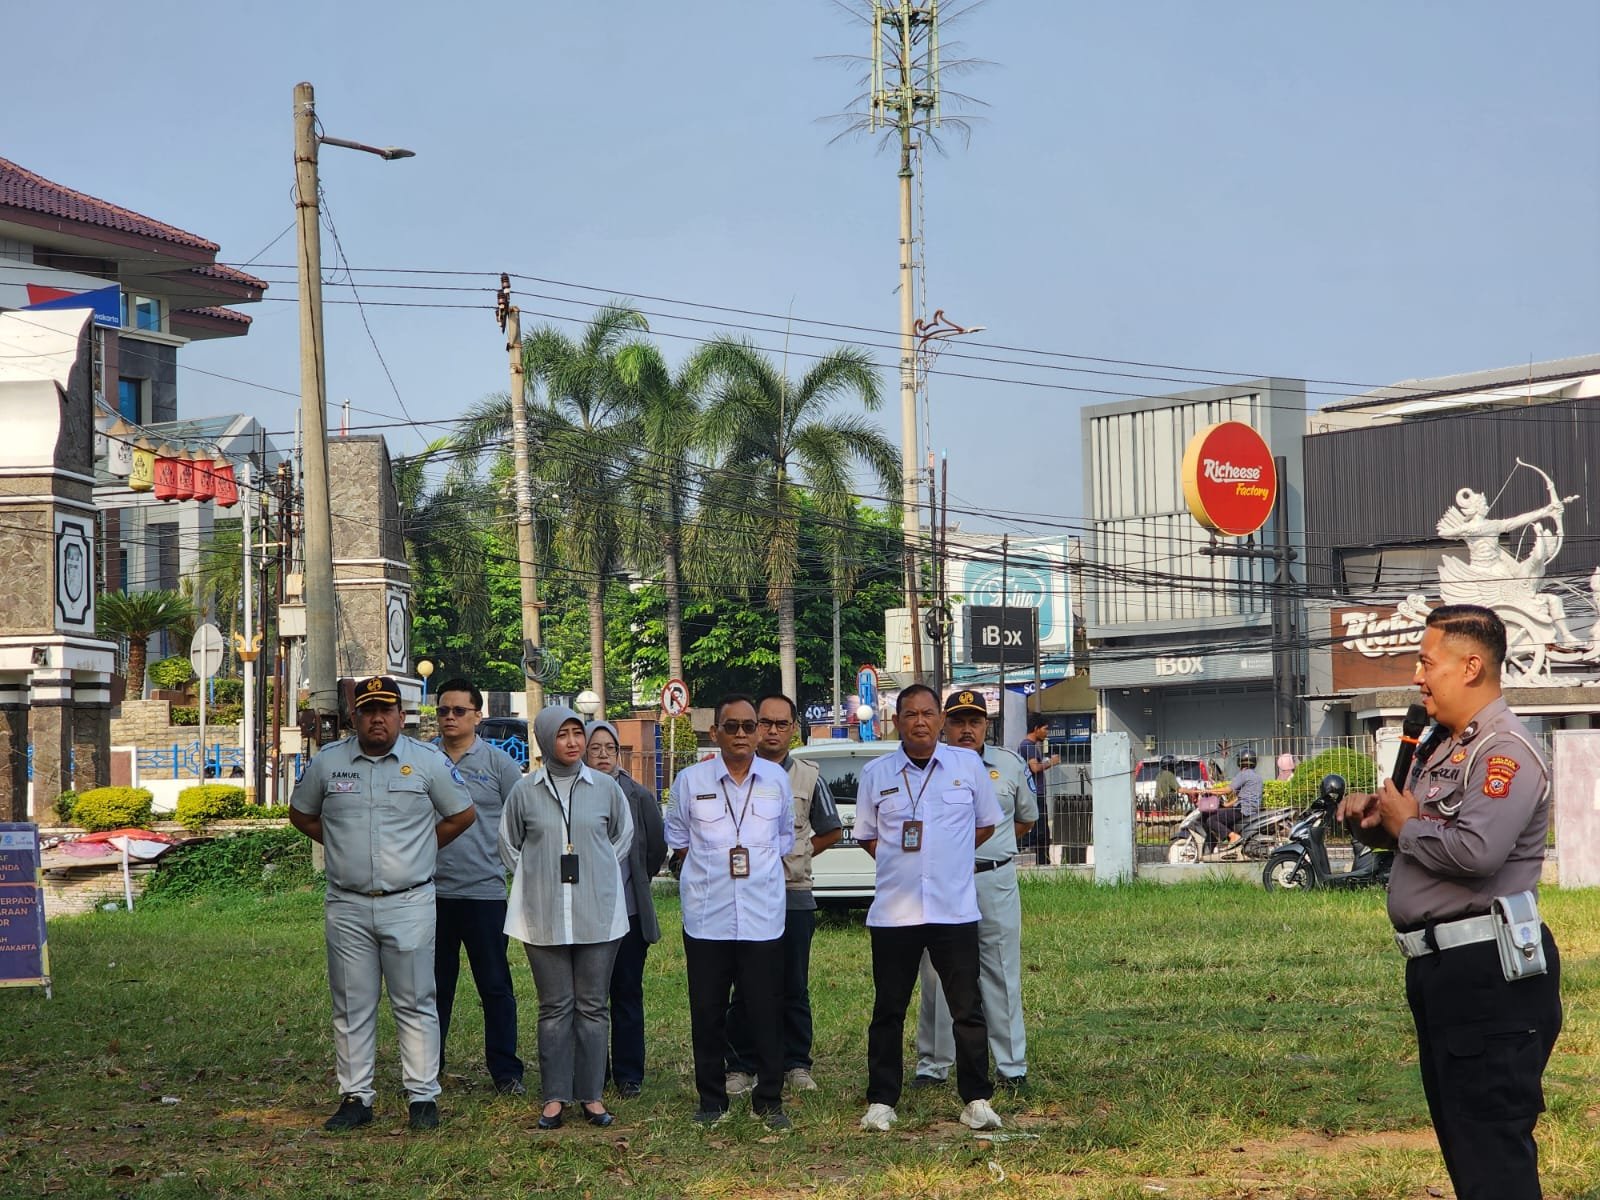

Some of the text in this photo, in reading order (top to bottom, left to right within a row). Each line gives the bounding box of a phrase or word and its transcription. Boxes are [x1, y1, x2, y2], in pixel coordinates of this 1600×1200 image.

[1203, 458, 1262, 483] Richeese
[1236, 483, 1269, 501] Factory
[332, 771, 361, 779] SAMUEL
